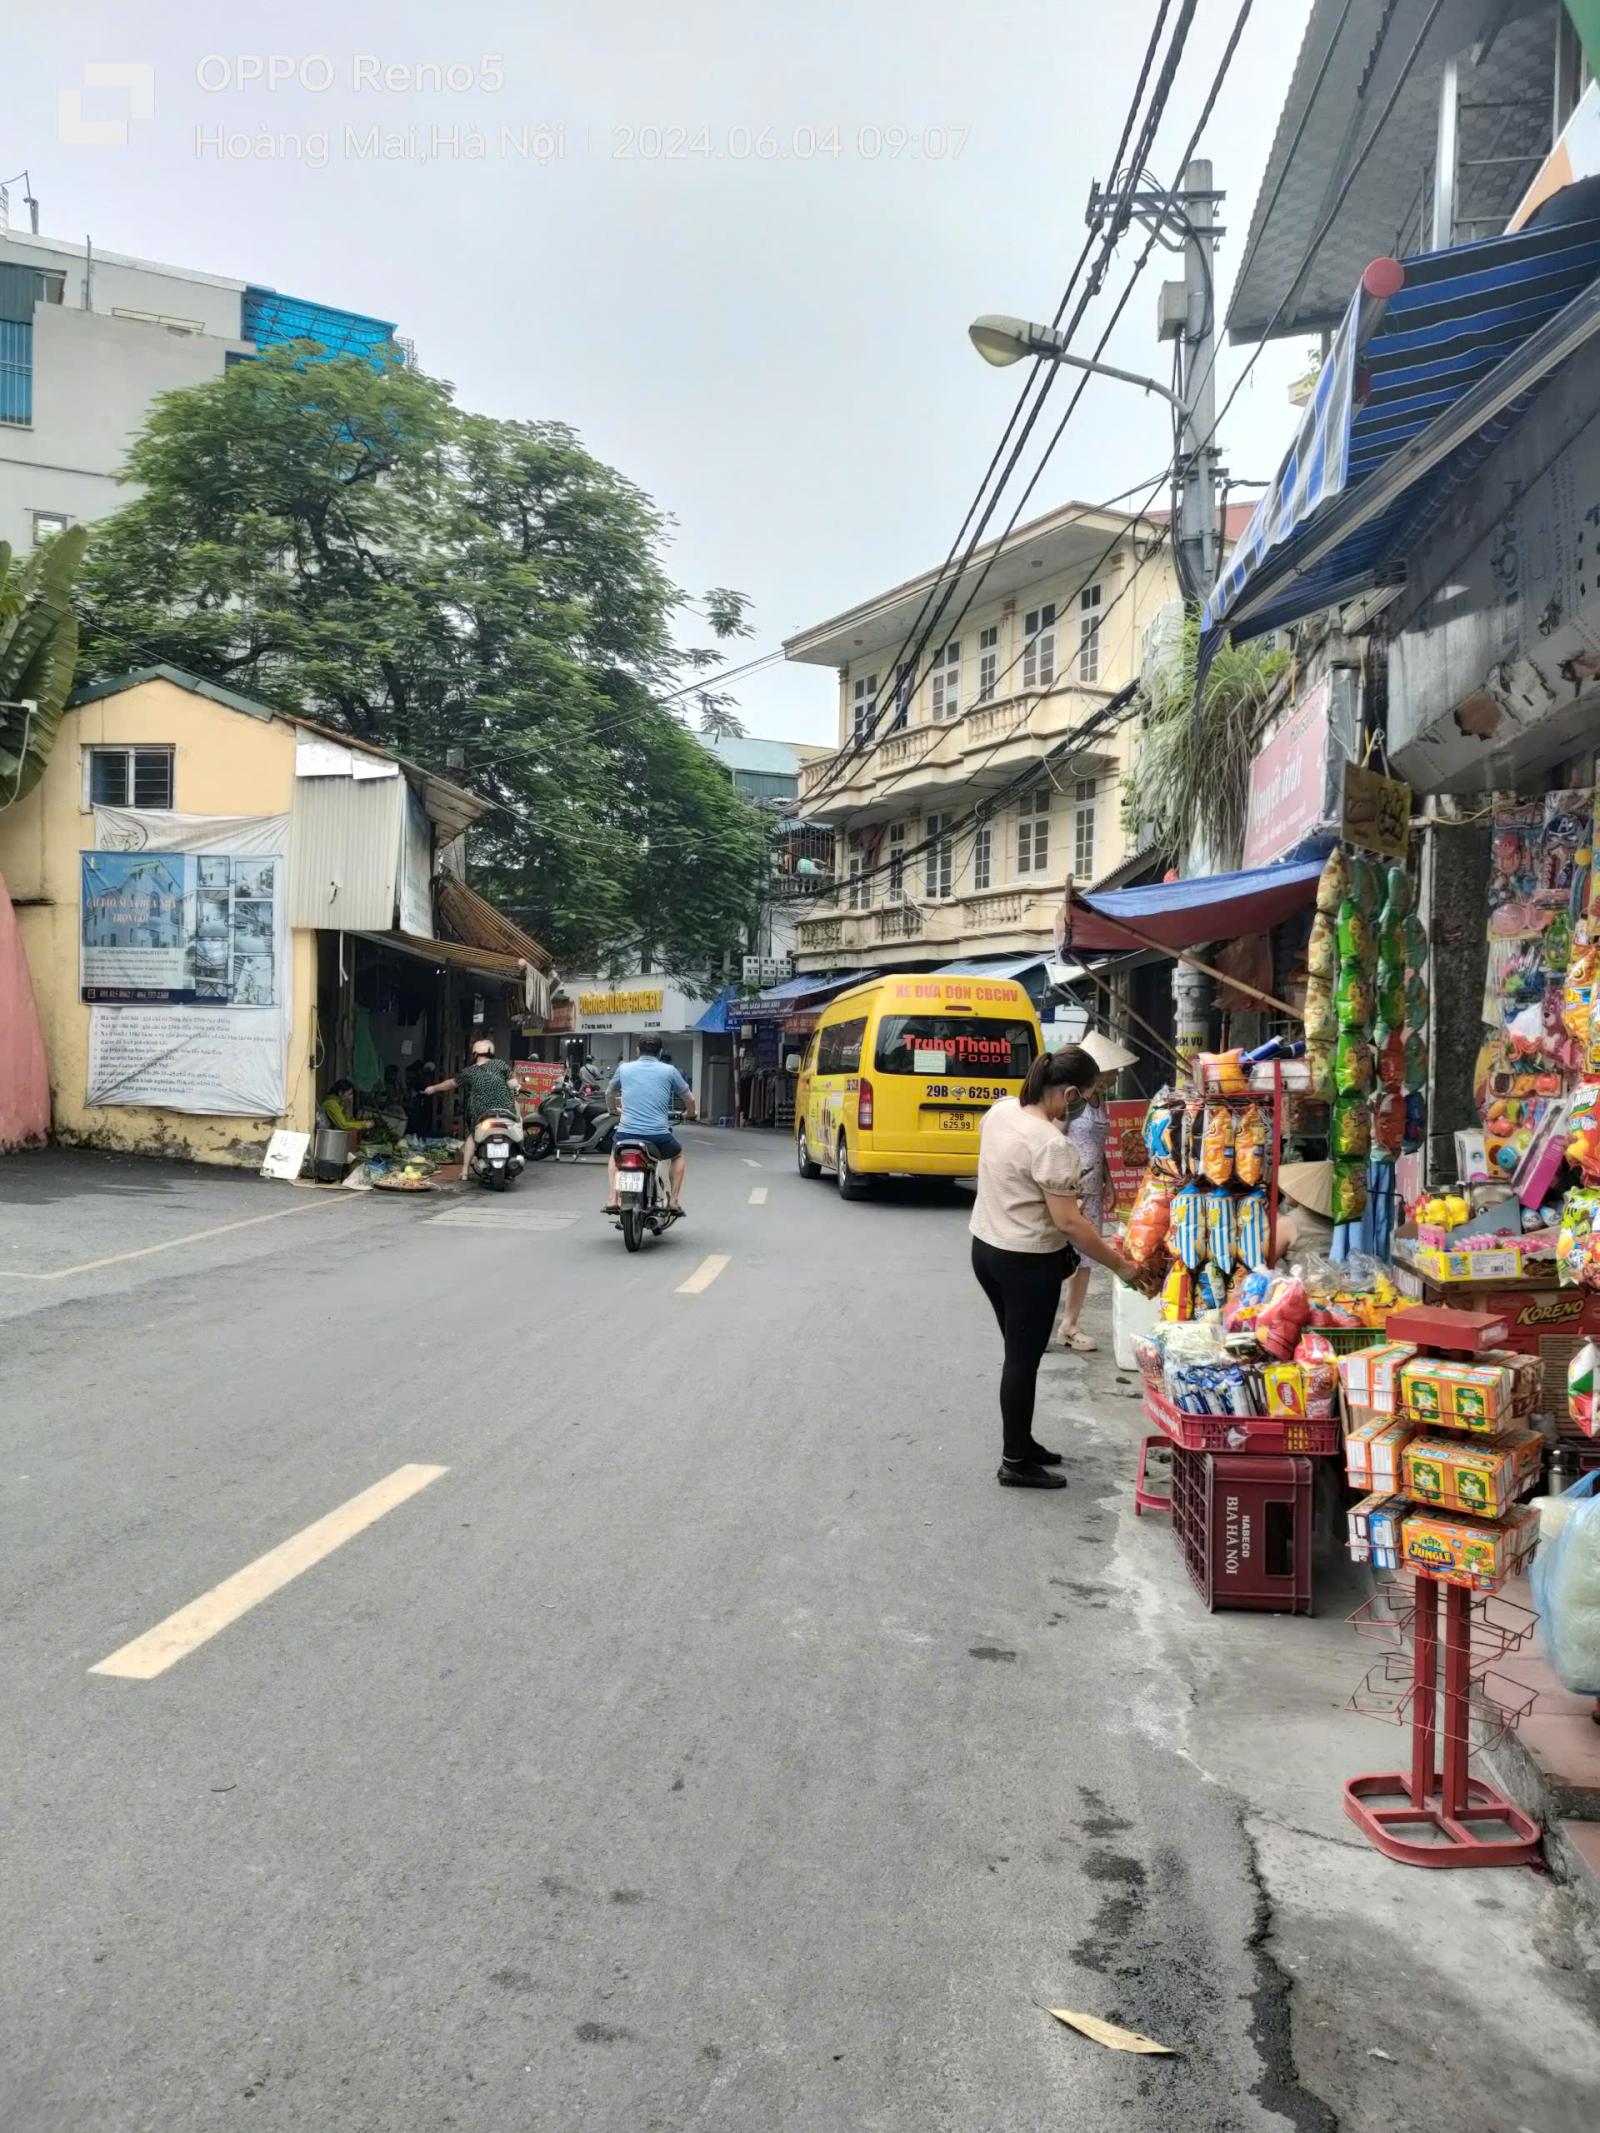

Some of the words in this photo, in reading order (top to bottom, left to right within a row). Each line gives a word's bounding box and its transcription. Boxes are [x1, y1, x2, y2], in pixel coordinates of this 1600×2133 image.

[896, 984, 911, 998] XE
[959, 1053, 1012, 1064] FOODS
[926, 1085, 948, 1097] 29B
[968, 1086, 1007, 1100] 625.99
[950, 1113, 965, 1121] 29B
[943, 1121, 971, 1130] 625.99
[1516, 1299, 1585, 1325] KORENO
[1227, 1496, 1239, 1522] BIA
[1242, 1515, 1250, 1557] HABECO
